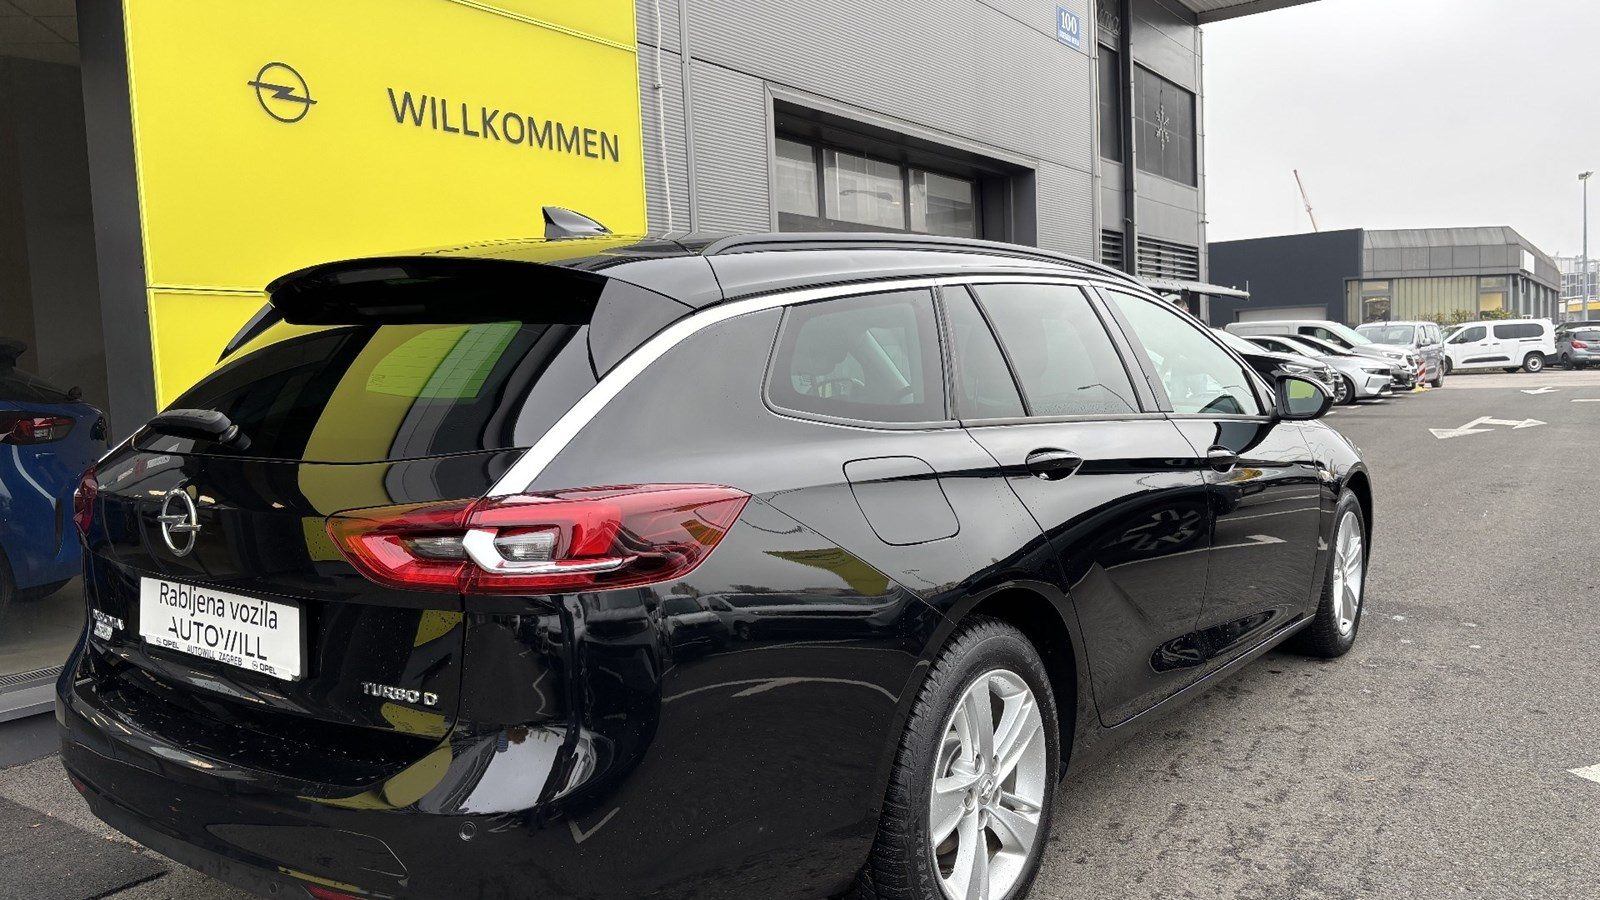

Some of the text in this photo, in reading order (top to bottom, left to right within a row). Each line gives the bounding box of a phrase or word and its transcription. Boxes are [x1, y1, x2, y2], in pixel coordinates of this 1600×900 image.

[1061, 11, 1077, 35] 100
[387, 87, 619, 162] WILLKOMMEN
[159, 582, 278, 629] Rabljena vozila
[163, 639, 277, 675] OPEL AUTOWILL ZAGREB OPEL
[168, 616, 267, 661] AUTOWILL
[361, 682, 438, 706] TURBO D
